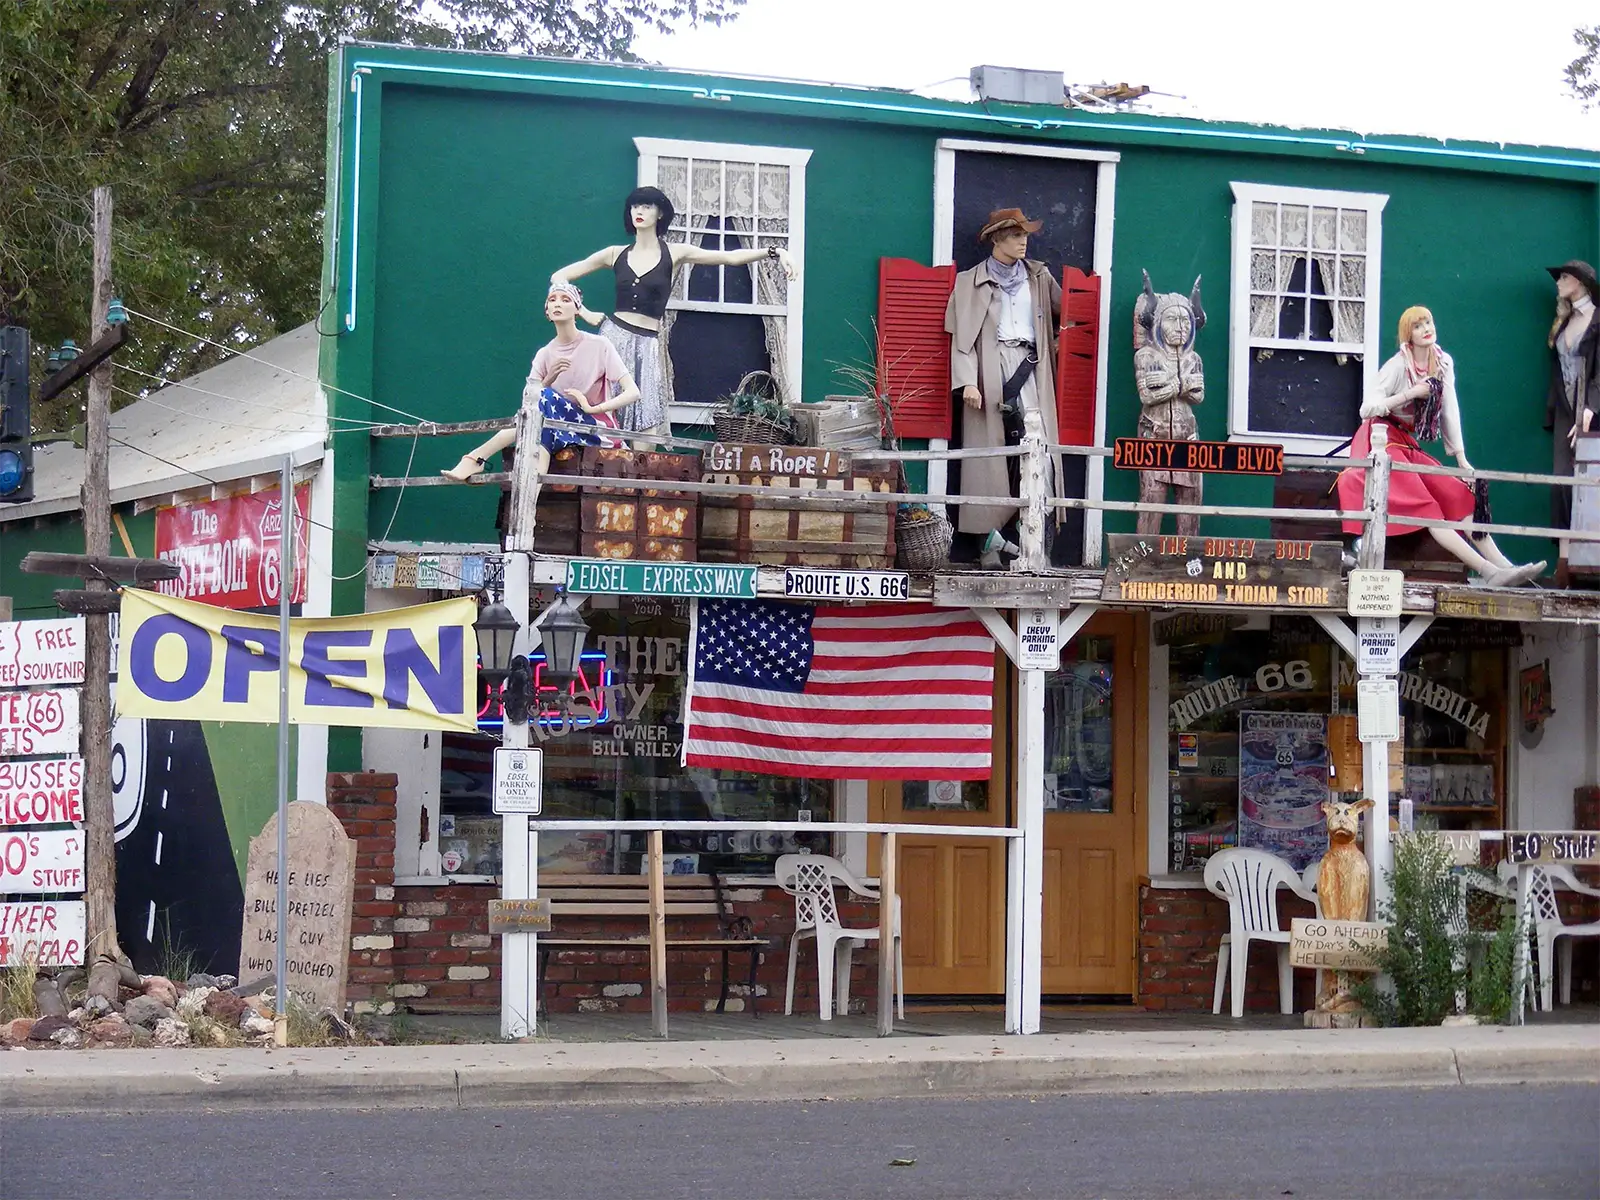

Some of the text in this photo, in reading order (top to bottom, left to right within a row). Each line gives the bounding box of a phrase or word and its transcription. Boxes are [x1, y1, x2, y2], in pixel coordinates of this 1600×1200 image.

[1123, 441, 1275, 471] RUSTY BOLT BLVD
[191, 509, 218, 536] The
[1159, 536, 1313, 561] THE RUSTY BOLT
[579, 565, 746, 595] EDSEL EXPRESSWAY
[1212, 561, 1247, 581] AND
[794, 574, 841, 596] ROUTE
[880, 577, 899, 598] 66
[1119, 581, 1329, 605] THUNDERBIRD INDIAN STORE
[35, 627, 77, 650] FREE
[1021, 635, 1056, 643] PARKING
[1026, 626, 1051, 635] CHEVY
[1028, 644, 1048, 652] ONLY
[1361, 639, 1396, 647] PARKING
[1369, 647, 1389, 655] ONLY
[130, 613, 464, 714] OPEN
[597, 634, 682, 677] THE
[23, 661, 85, 681] SOUVENIR
[1169, 674, 1241, 731] ROUTE
[1255, 660, 1316, 693] 66
[33, 698, 57, 723] 66
[612, 724, 668, 740] OWNER
[592, 740, 684, 758] BILL RILEY
[1277, 751, 1293, 764] 66
[512, 762, 524, 770] 66
[507, 773, 529, 781] EDSEL
[33, 868, 81, 887] STUFF
[266, 870, 330, 887] HEE LIES
[254, 899, 335, 917] BILL PRETZEL
[258, 928, 325, 946] LAS GUY
[1304, 923, 1327, 937] GO
[1294, 938, 1313, 949] MY
[1315, 939, 1344, 951] DAY'S
[248, 957, 334, 977] WHO TOUCHED
[1295, 952, 1331, 965] HELL
